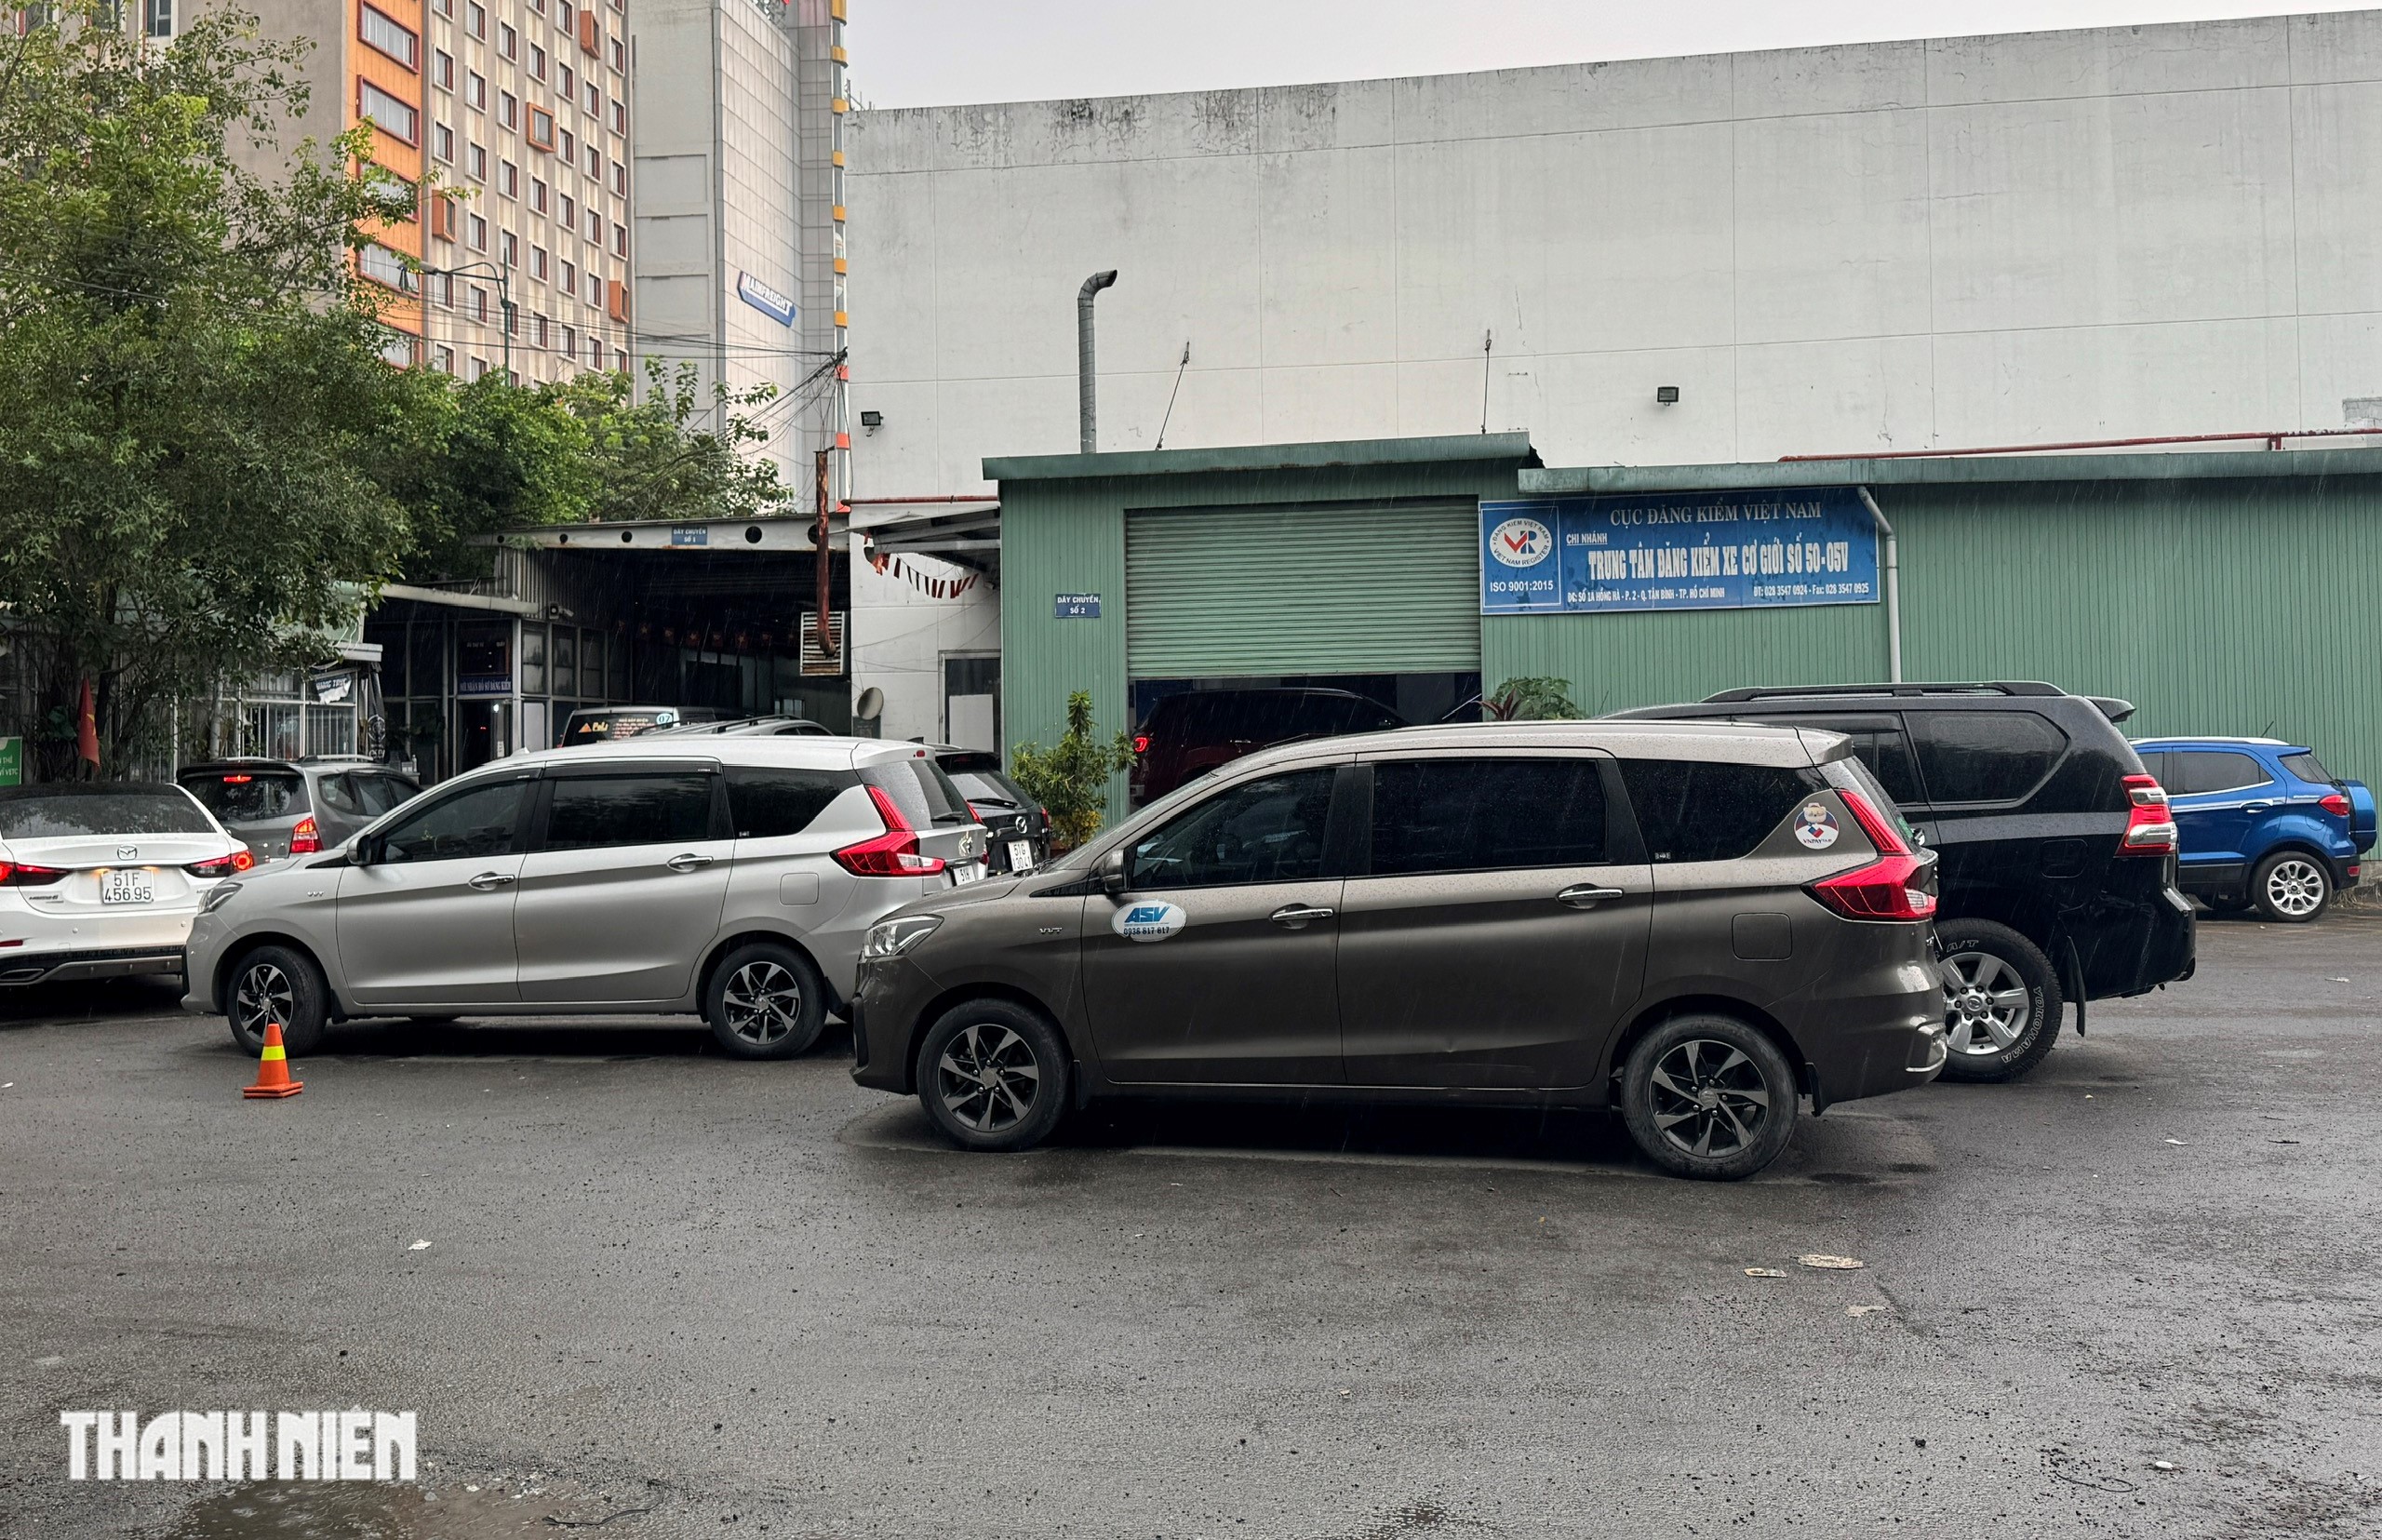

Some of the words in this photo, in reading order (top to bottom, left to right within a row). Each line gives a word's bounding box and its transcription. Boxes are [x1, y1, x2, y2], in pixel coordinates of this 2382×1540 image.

[1610, 509, 1643, 529] CỤC
[1647, 504, 1693, 525] ĐĂNG
[1743, 500, 1781, 524] VIỆT
[1786, 502, 1823, 519] NAM
[1566, 533, 1580, 544] CHI
[1581, 530, 1608, 544] NHÁNH
[1521, 545, 1550, 566] REGISTER
[1588, 549, 1627, 581] TRUNG
[1629, 541, 1655, 579] TÂM
[1657, 541, 1688, 578] ĐĂNG
[1690, 531, 1720, 578] KIỂM
[1722, 545, 1739, 576] XE
[1742, 539, 1758, 575] CƠ
[1760, 536, 1785, 575] GIỚI
[1786, 531, 1803, 574] SỐ
[1805, 542, 1849, 574] 50-05V
[1490, 582, 1506, 593] ISO
[1508, 580, 1554, 592] 9001:2015
[1057, 596, 1071, 604] DÂY
[1632, 590, 1637, 601] 2
[1069, 604, 1079, 614] SỐ
[1013, 843, 1025, 856] 51G
[114, 872, 141, 888] 51F
[104, 887, 152, 903] 456.95
[1124, 906, 1170, 923] ASV
[1946, 939, 1979, 953] A/T
[2001, 985, 2045, 1064] YOKOHAMA
